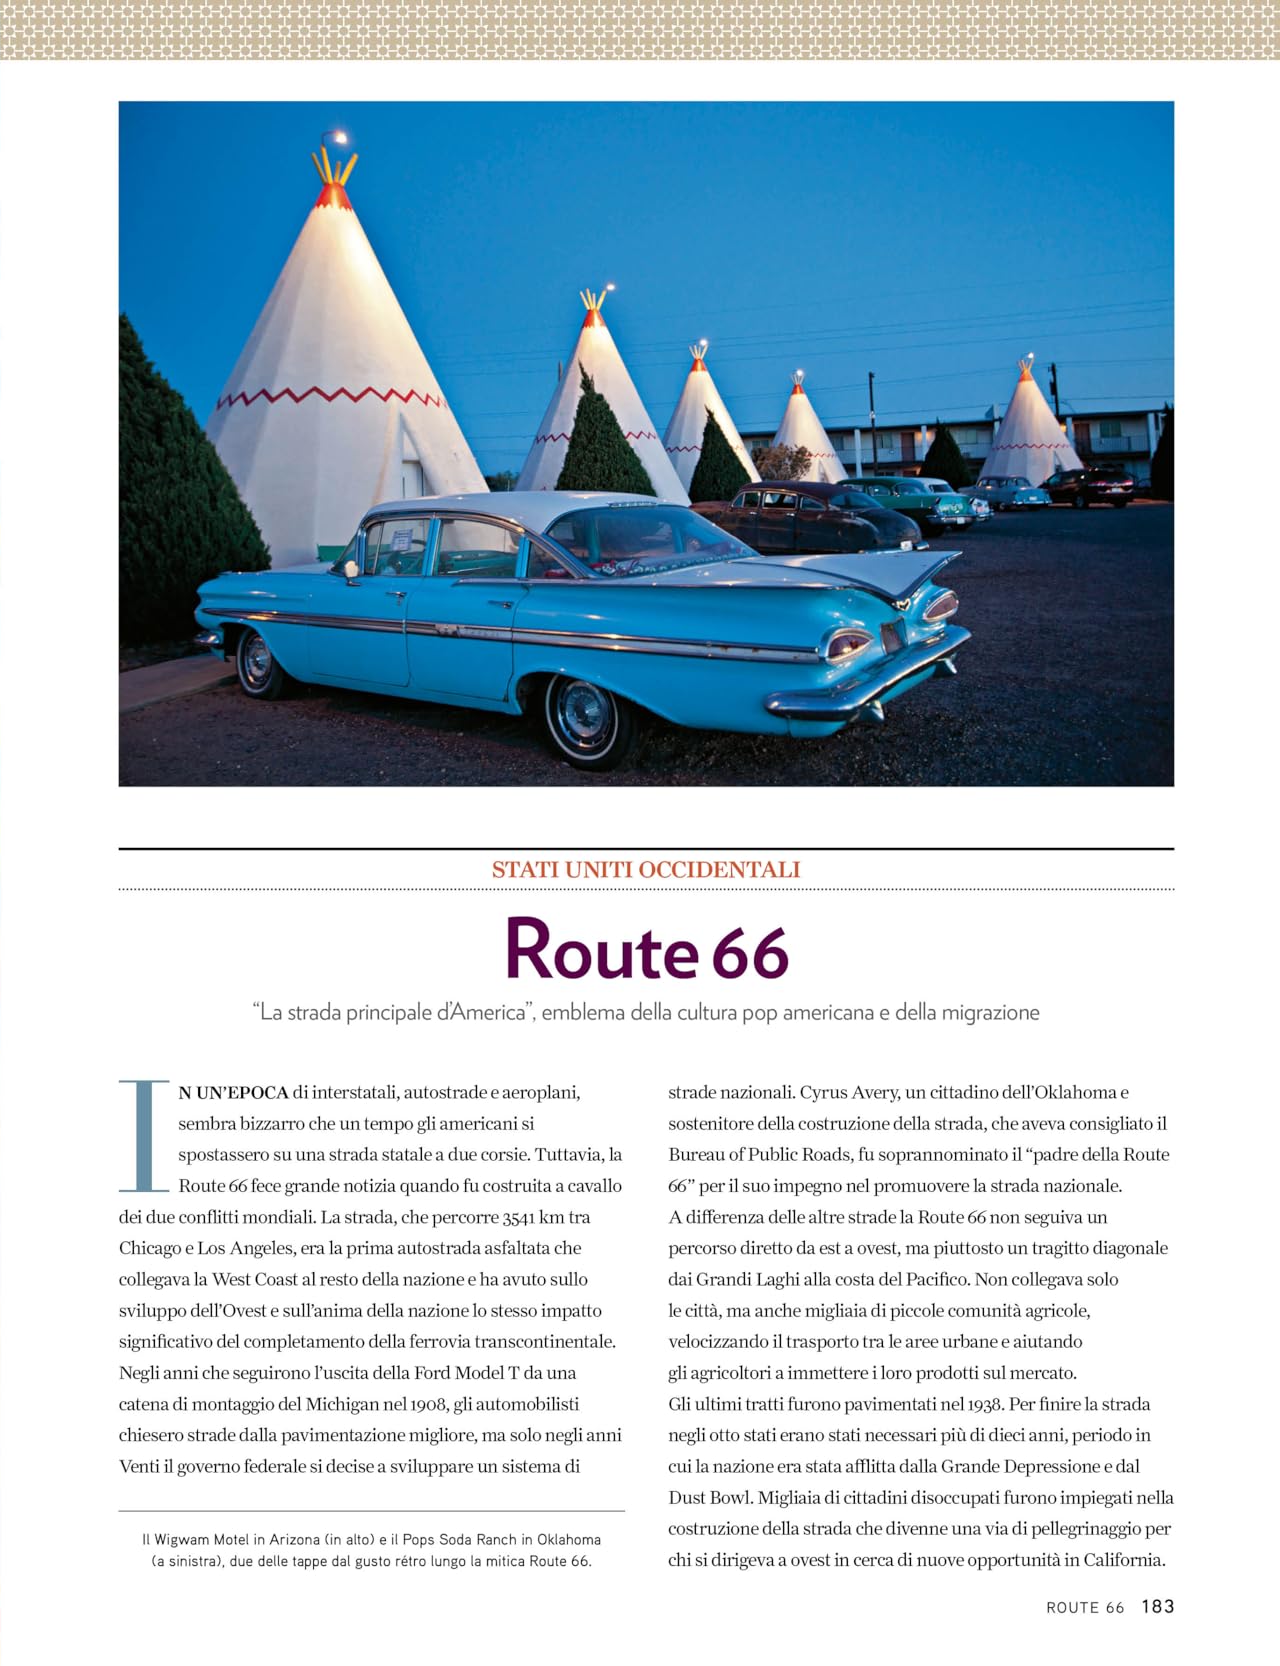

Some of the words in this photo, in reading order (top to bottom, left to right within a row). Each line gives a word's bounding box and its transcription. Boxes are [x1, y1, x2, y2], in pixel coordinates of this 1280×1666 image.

[492, 860, 560, 879] STATI
[564, 860, 633, 879] UNITI
[638, 860, 801, 879] OCCIDENTALI
[507, 915, 700, 980] Route
[712, 926, 790, 980] 66
[287, 1001, 341, 1021] strada
[346, 1001, 433, 1026] principale
[541, 1001, 625, 1021] emblema
[630, 1001, 672, 1021] della
[677, 1001, 737, 1021] cultura
[742, 1008, 778, 1026] pop
[783, 1004, 875, 1021] americana
[879, 1008, 890, 1021] e
[895, 1001, 937, 1021] della
[942, 1004, 1041, 1026] migrazione
[178, 1085, 192, 1100] N
[292, 1084, 309, 1100] di
[311, 1084, 401, 1102] interstatali,
[403, 1084, 488, 1100] autostrade
[490, 1088, 500, 1100] e
[502, 1083, 581, 1104] aeroplani,
[668, 1084, 717, 1100] strade
[719, 1084, 797, 1100] nazionali.
[799, 1084, 848, 1104] Cyrus
[851, 1084, 902, 1104] Avery,
[905, 1088, 926, 1100] un
[929, 1084, 1000, 1100] cittadino
[1120, 1088, 1130, 1100] e
[178, 1147, 270, 1166] spostassero
[273, 1150, 293, 1162] su
[295, 1150, 326, 1162] una
[328, 1146, 379, 1162] strada
[381, 1146, 433, 1162] statale
[435, 1150, 445, 1162] a
[447, 1146, 478, 1162] due
[480, 1146, 531, 1162] corsie.
[534, 1146, 606, 1165] Tuttavia,
[608, 1146, 623, 1162] la
[698, 1182, 726, 1197] per
[728, 1177, 739, 1193] il
[742, 1182, 771, 1193] suo
[773, 1178, 843, 1197] impegno
[845, 1177, 870, 1193] nel
[873, 1182, 970, 1197] promuovere
[972, 1177, 988, 1193] la
[990, 1177, 1040, 1193] strada
[1043, 1177, 1123, 1193] nazionale.
[118, 1208, 143, 1225] dei
[145, 1208, 176, 1225] due
[178, 1208, 239, 1225] conflitti
[242, 1208, 317, 1225] mondiali.
[320, 1209, 342, 1225] La
[344, 1209, 398, 1227] strada,
[401, 1208, 429, 1225] che
[431, 1213, 500, 1229] percorre
[502, 1212, 536, 1227] 3541
[538, 1208, 565, 1225] km
[568, 1210, 591, 1225] tra
[119, 1302, 188, 1322] sviluppo
[270, 1307, 280, 1318] e
[366, 1302, 405, 1318] della
[407, 1302, 470, 1318] nazione
[472, 1302, 488, 1318] lo
[490, 1303, 538, 1318] stesso
[541, 1302, 603, 1322] impatto
[668, 1302, 682, 1318] le
[684, 1302, 723, 1321] città,
[726, 1306, 752, 1318] ma
[754, 1302, 802, 1318] anche
[804, 1302, 868, 1322] migliaia
[870, 1302, 887, 1318] di
[889, 1302, 945, 1322] piccole
[947, 1302, 1022, 1318] comunità
[1025, 1302, 1091, 1322] agricole,
[118, 1397, 170, 1412] catena
[172, 1395, 188, 1412] di
[191, 1396, 276, 1416] montaggio
[278, 1395, 302, 1412] del
[305, 1395, 380, 1416] Michigan
[383, 1395, 408, 1412] nel
[410, 1397, 450, 1414] 1908,
[453, 1395, 473, 1416] gli
[475, 1395, 580, 1412] automobilisti
[668, 1395, 691, 1412] Gli
[694, 1395, 742, 1412] ultimi
[745, 1396, 784, 1412] tratti
[788, 1395, 842, 1412] furono
[844, 1396, 937, 1416] pavimentati
[940, 1395, 965, 1412] nel
[968, 1397, 1006, 1414] 1938.
[1009, 1396, 1037, 1412] Per
[1039, 1395, 1082, 1412] finire
[1084, 1395, 1099, 1412] la
[1101, 1395, 1151, 1412] strada
[142, 1533, 150, 1546] Il
[154, 1532, 210, 1549] Wigwam
[214, 1533, 249, 1546] Motel
[253, 1533, 266, 1546] in
[269, 1533, 321, 1546] Arizona
[324, 1532, 342, 1546] (in
[345, 1533, 375, 1546] alto)
[379, 1536, 387, 1546] e
[391, 1533, 399, 1546] il
[403, 1533, 435, 1549] Pops
[439, 1532, 472, 1546] Soda
[476, 1532, 517, 1546] Ranch
[521, 1533, 533, 1546] in
[537, 1532, 601, 1546] Oklahoma
[151, 1554, 165, 1567] (a
[168, 1554, 225, 1569] sinistra),
[229, 1554, 254, 1567] due
[257, 1554, 289, 1568] delle
[292, 1555, 328, 1571] tappe
[331, 1554, 351, 1567] dal
[354, 1555, 391, 1570] gusto
[395, 1554, 427, 1567] rétro
[430, 1554, 467, 1570] lungo
[470, 1554, 482, 1567] la
[486, 1554, 525, 1568] mitica
[529, 1554, 567, 1568] Route
[571, 1554, 592, 1567] 66.
[667, 1551, 692, 1567] chi
[695, 1551, 709, 1567] si
[711, 1551, 776, 1572] dirigeva
[777, 1556, 788, 1567] a
[790, 1553, 831, 1567] ovest
[833, 1552, 850, 1568] in
[853, 1556, 895, 1567] cerca
[897, 1551, 913, 1567] di
[916, 1556, 965, 1567] nuove
[967, 1552, 1062, 1572] opportunità
[1064, 1552, 1081, 1567] in
[1083, 1551, 1166, 1567] California.
[1046, 1601, 1099, 1614] ROUTE
[1106, 1601, 1125, 1614] 66
[1142, 1598, 1175, 1614] 183
